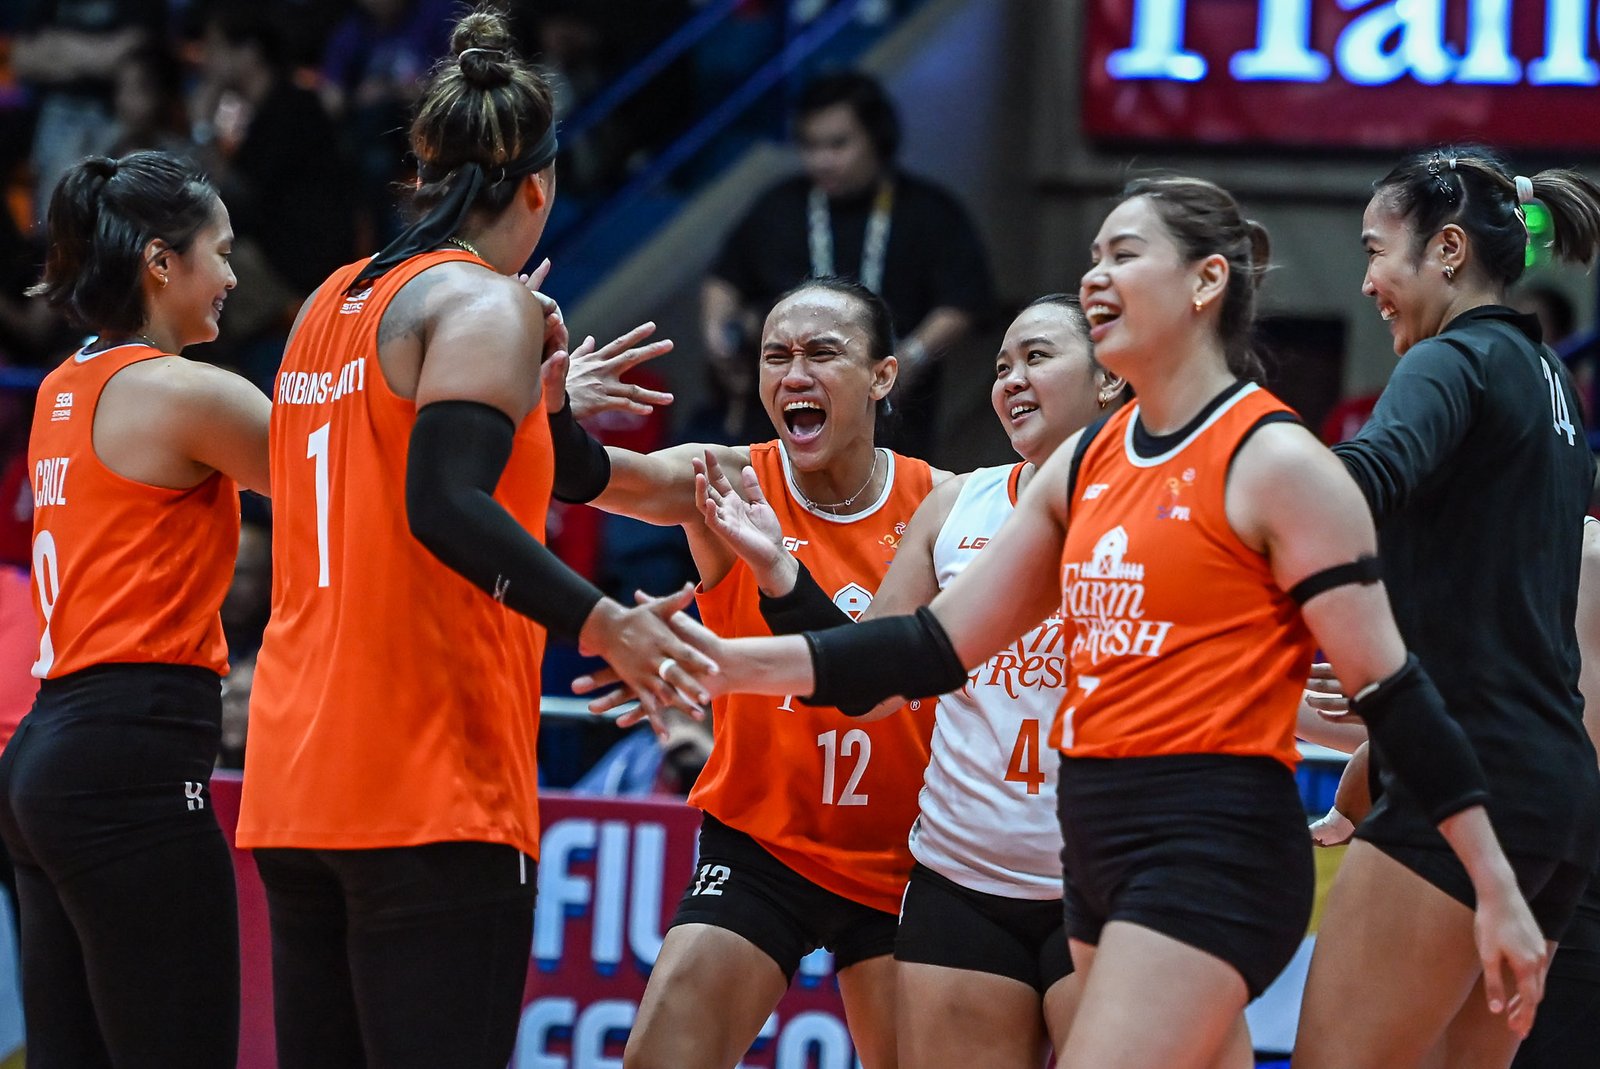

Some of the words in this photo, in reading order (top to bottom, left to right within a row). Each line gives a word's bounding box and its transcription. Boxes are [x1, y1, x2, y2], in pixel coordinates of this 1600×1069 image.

[35, 457, 70, 508] CRUZ
[306, 421, 330, 588] 1
[817, 728, 872, 806] 12
[1003, 718, 1045, 796] 4
[692, 863, 731, 897] 12
